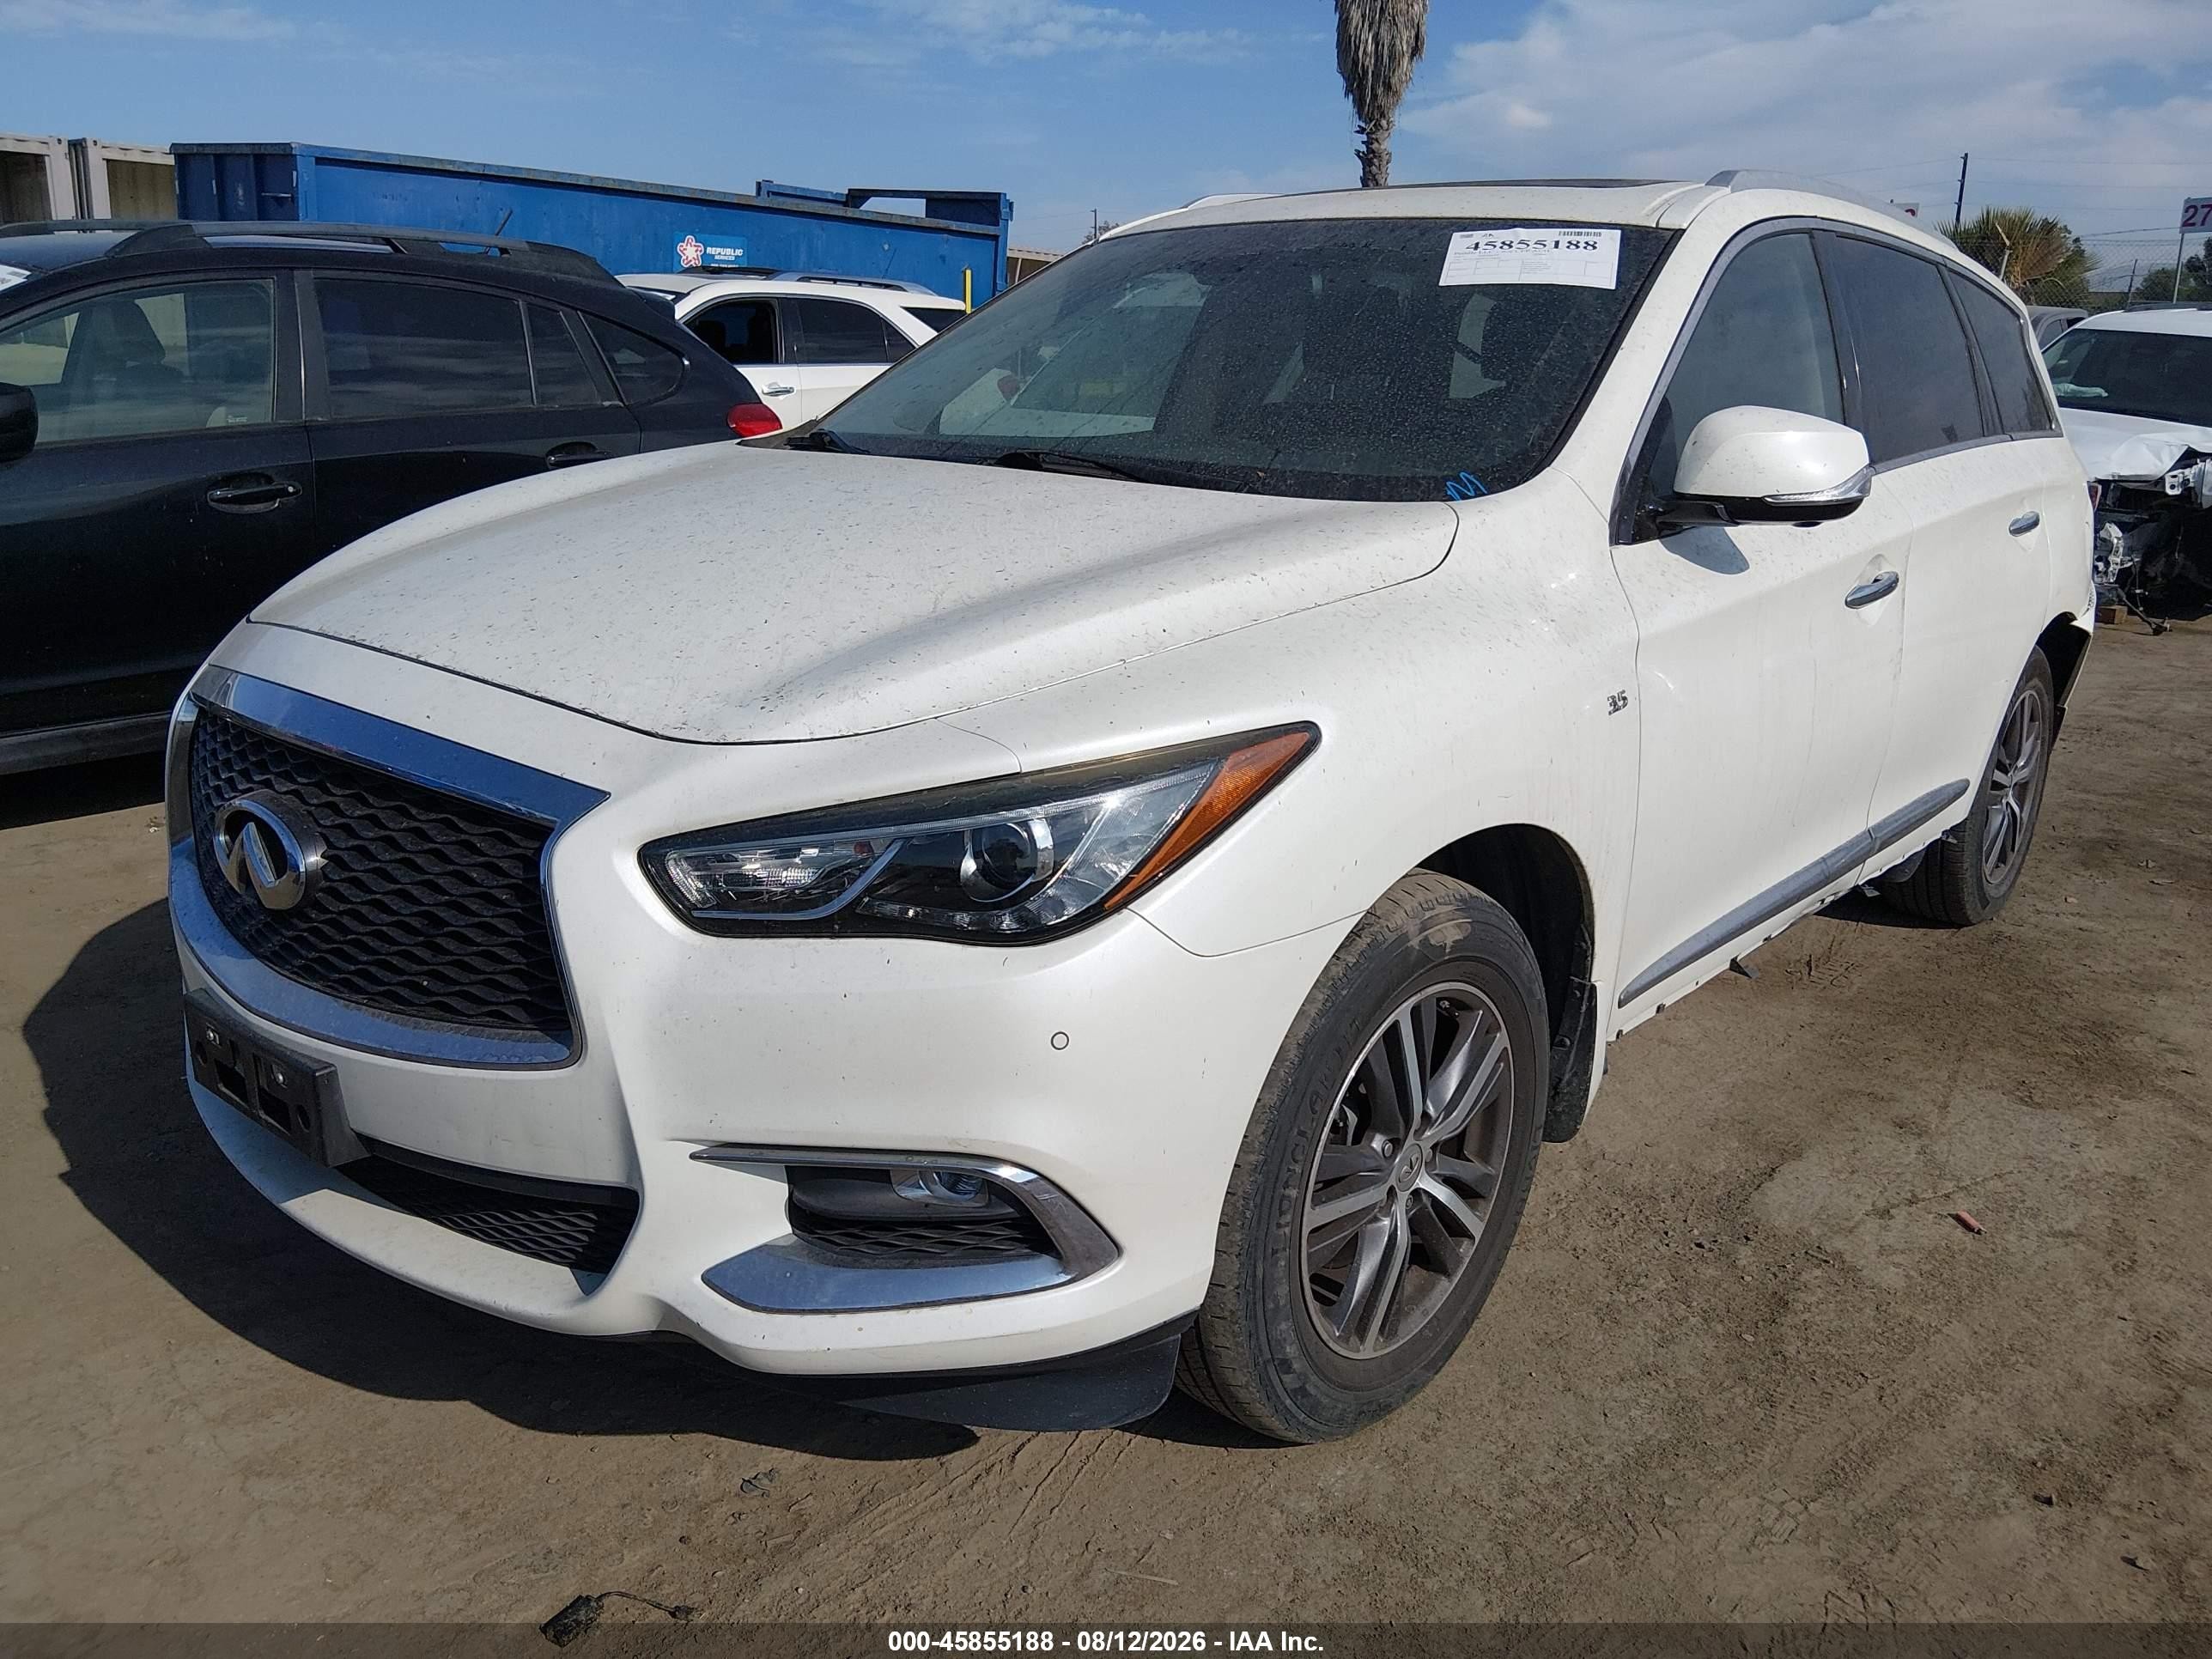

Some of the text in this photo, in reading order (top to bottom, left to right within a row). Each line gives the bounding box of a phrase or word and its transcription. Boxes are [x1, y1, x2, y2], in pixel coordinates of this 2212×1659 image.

[2182, 204, 2212, 228] 27
[706, 246, 744, 256] REPUBLIC
[1465, 239, 1599, 252] 45855188
